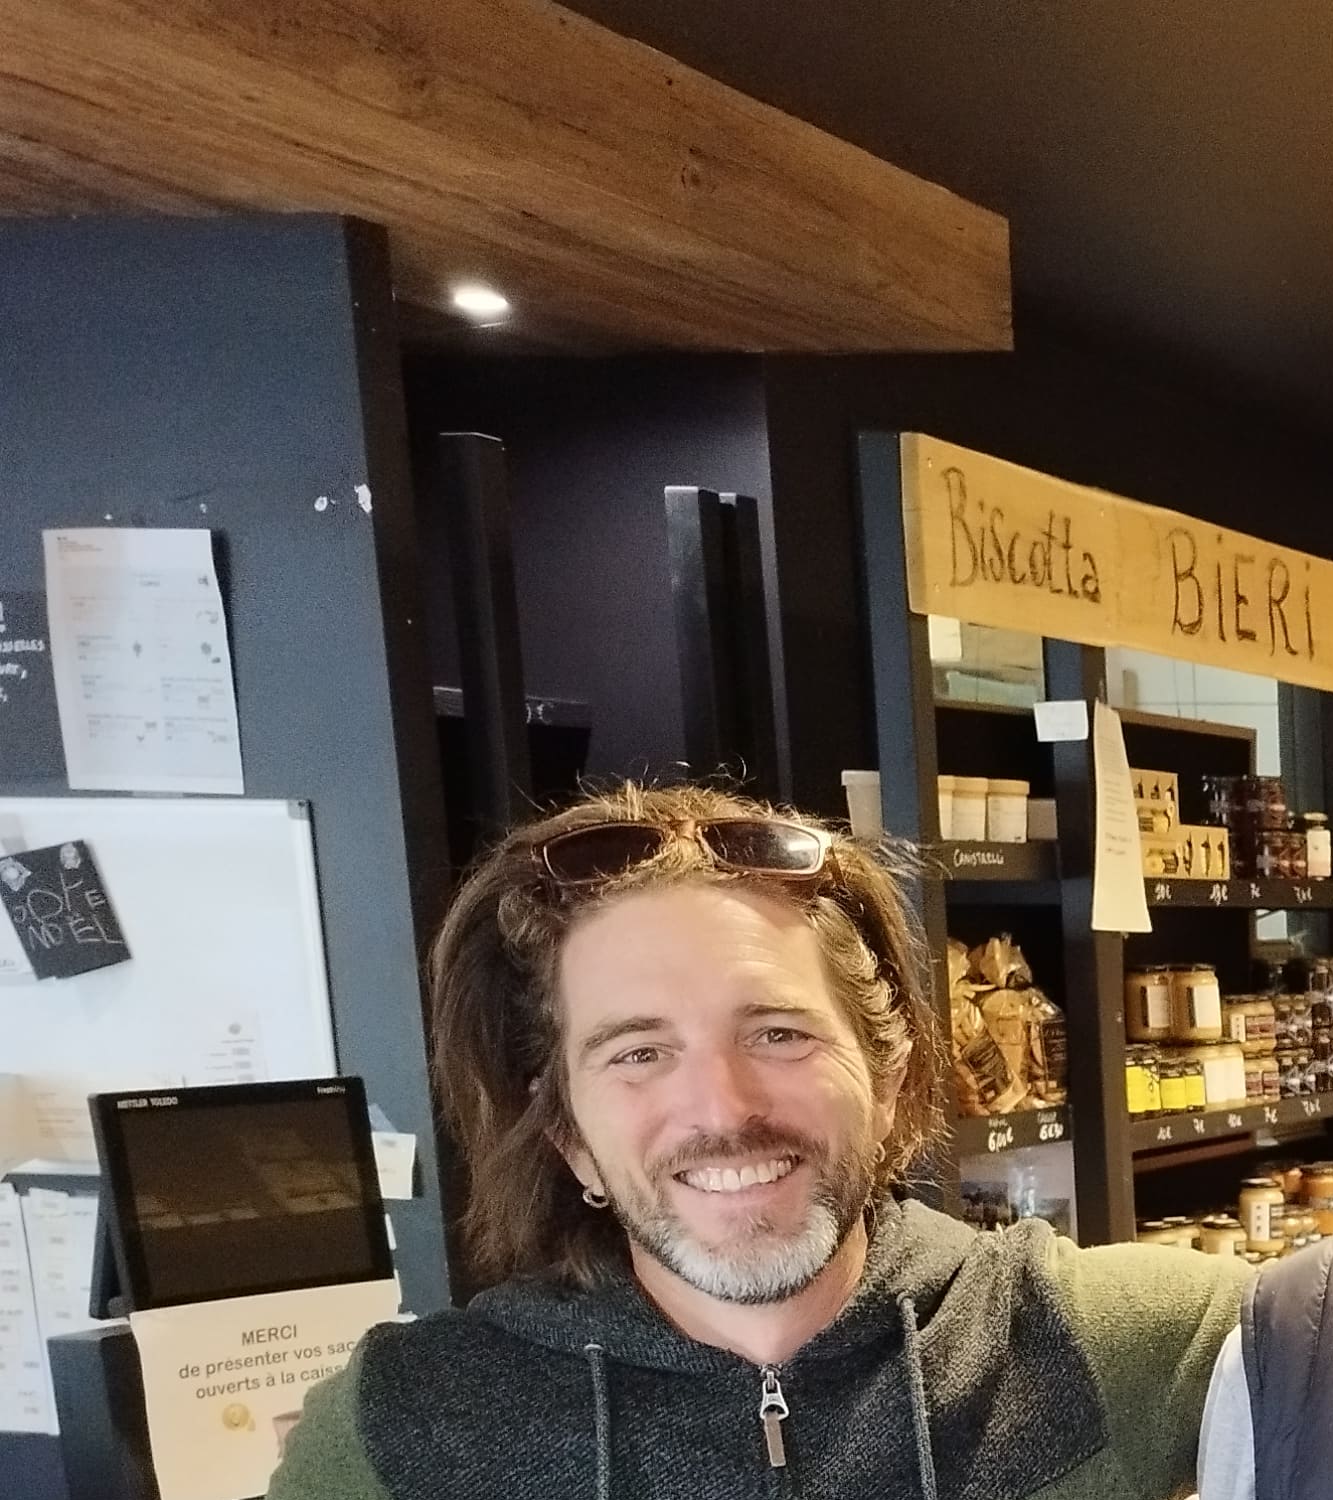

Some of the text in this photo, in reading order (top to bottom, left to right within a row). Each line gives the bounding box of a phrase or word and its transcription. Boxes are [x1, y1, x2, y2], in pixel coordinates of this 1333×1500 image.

[941, 466, 1101, 603] Biscotta
[241, 1324, 298, 1347] MERCI
[179, 1363, 200, 1379] de
[293, 1346, 322, 1360] vos
[327, 1340, 358, 1354] sac
[196, 1378, 261, 1400] ouverts
[281, 1370, 296, 1385] la
